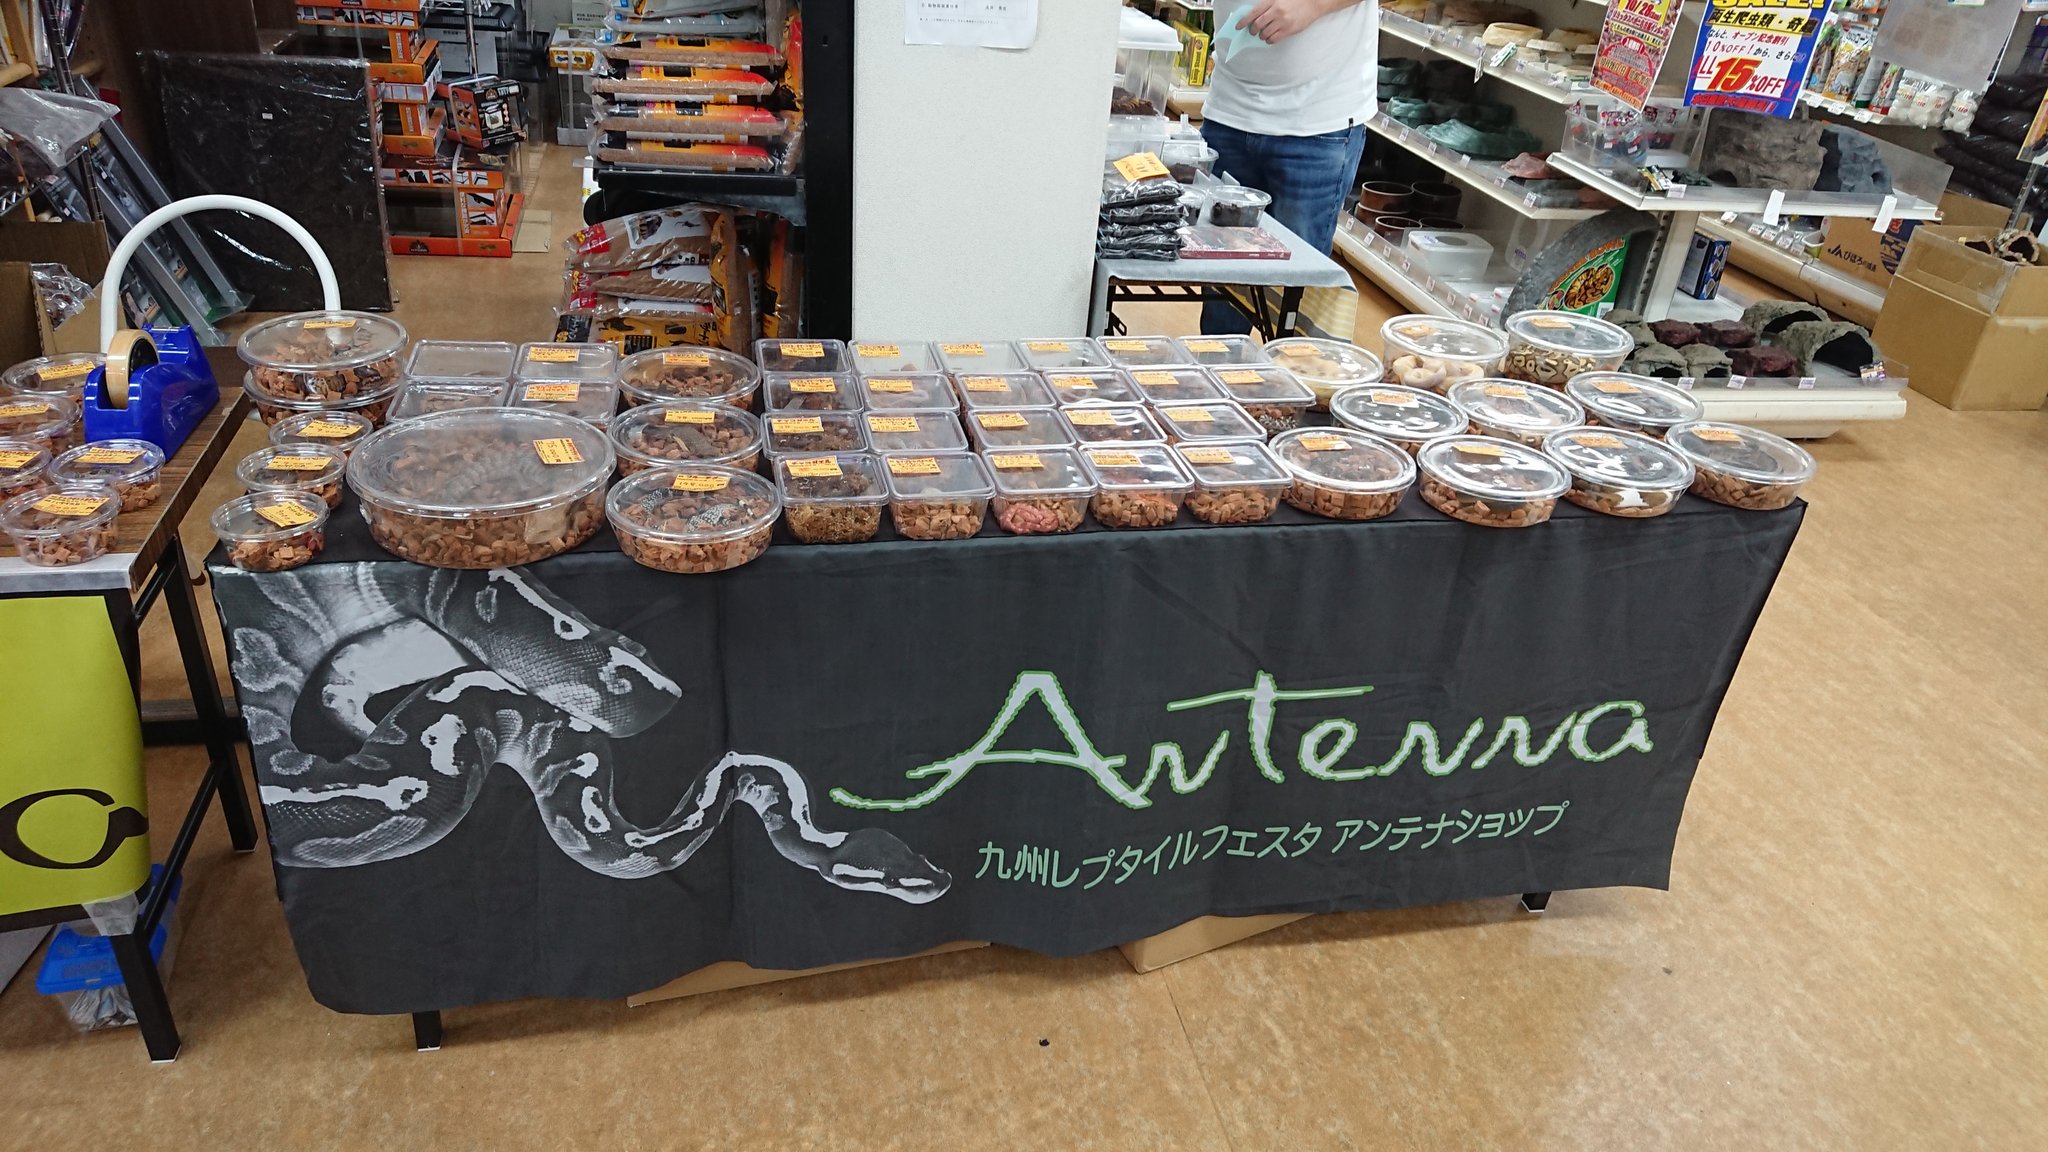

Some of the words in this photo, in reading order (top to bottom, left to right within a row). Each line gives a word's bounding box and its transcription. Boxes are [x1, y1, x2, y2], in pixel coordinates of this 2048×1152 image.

[1692, 55, 1717, 75] ALL
[829, 669, 1655, 812] Antenna
[975, 821, 1323, 890] 九州レプタイルフェスタ
[1330, 799, 1571, 855] アンテナショップ
